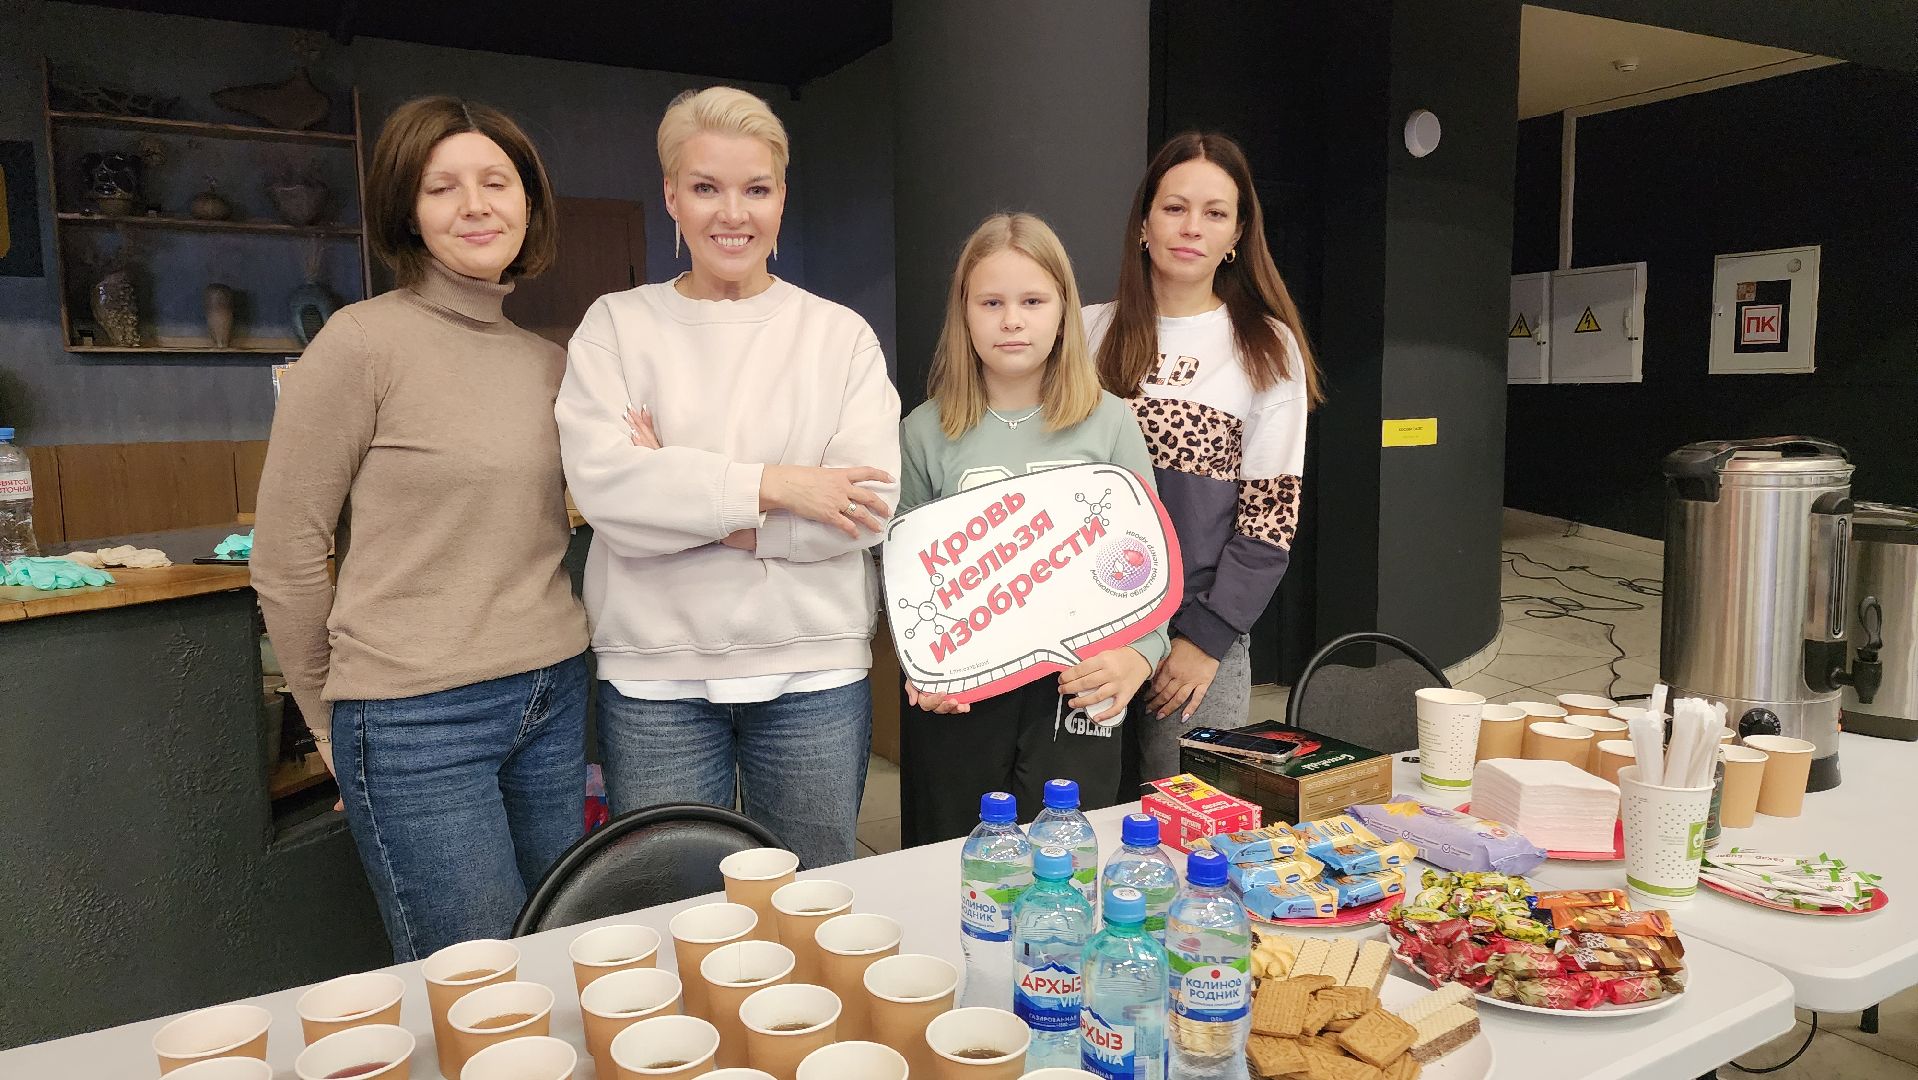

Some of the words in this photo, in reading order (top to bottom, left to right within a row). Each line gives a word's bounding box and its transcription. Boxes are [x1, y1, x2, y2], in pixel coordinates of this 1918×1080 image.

[1746, 316, 1776, 334] ПК
[918, 492, 1026, 576] Кровь
[936, 509, 1055, 610] нельзя
[929, 516, 1107, 664] изобрести
[1081, 1015, 1123, 1051] РХЫЗ
